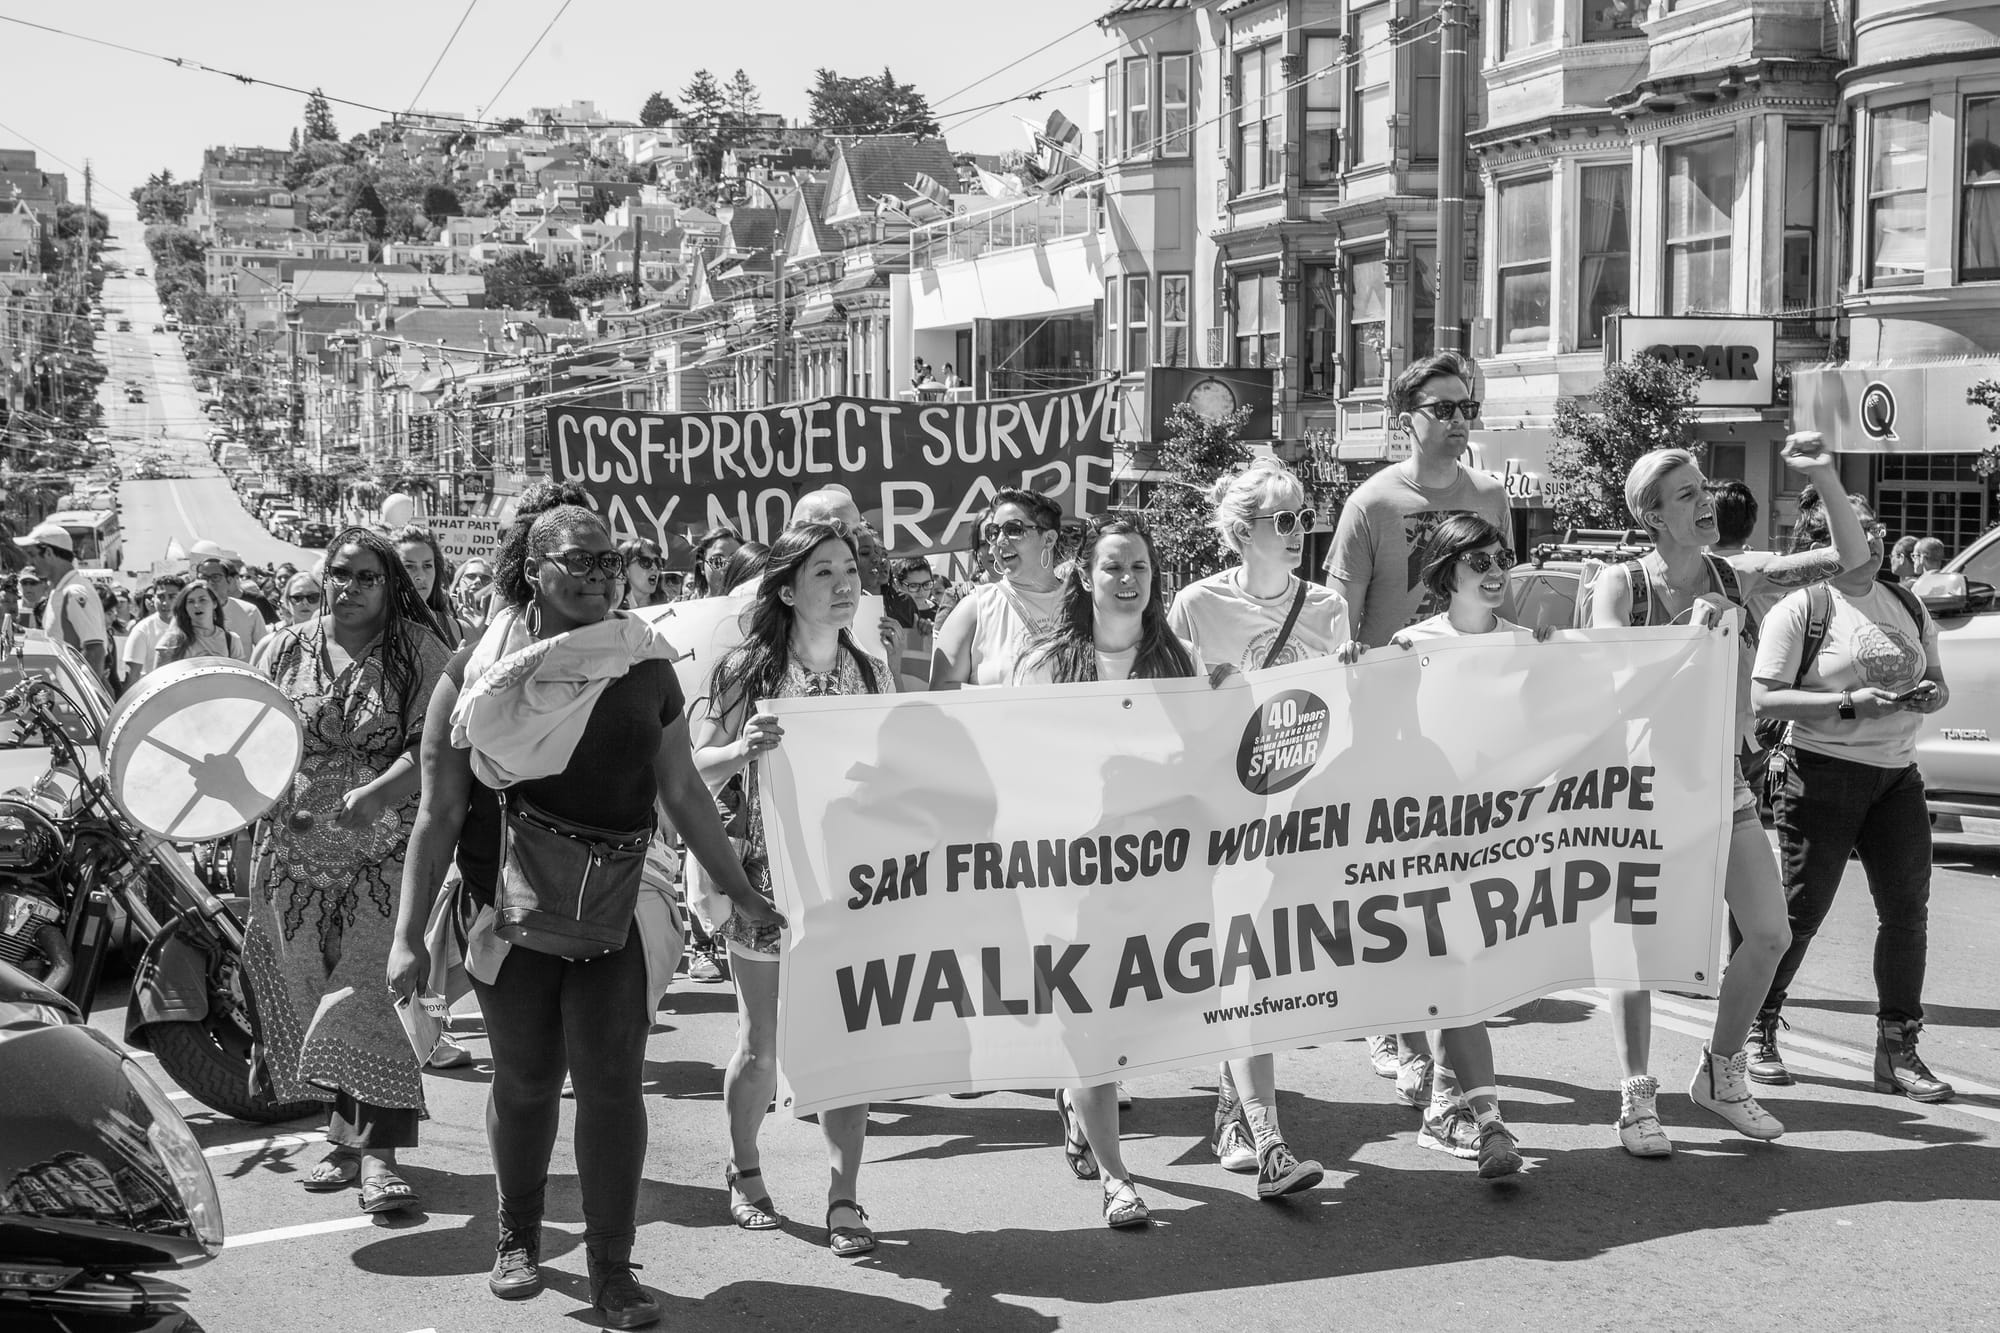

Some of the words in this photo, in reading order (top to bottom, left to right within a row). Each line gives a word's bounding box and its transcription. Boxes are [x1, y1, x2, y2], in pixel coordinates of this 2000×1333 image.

[428, 519, 465, 529] WHAT
[467, 520, 500, 531] PART
[472, 534, 495, 545] DID
[585, 492, 681, 560] AY
[441, 545, 463, 556] OU
[466, 546, 495, 557] NOT
[1268, 699, 1297, 729] 40
[1297, 709, 1326, 726] years
[1252, 741, 1277, 754] WOMEN
[1276, 734, 1304, 749] AGAINST
[1304, 730, 1321, 742] RAPE
[1254, 734, 1271, 745] SAN
[1275, 721, 1323, 740] FRANCISCO
[1248, 740, 1319, 777] SFWAR
[847, 851, 930, 909] SAN
[945, 828, 1190, 893] FRANCISCO
[1208, 803, 1350, 866] WOMEN
[1365, 786, 1545, 844] AGAINST
[1547, 766, 1655, 814] RAPE
[1344, 859, 1396, 885] SAN
[1403, 831, 1555, 878] FRANCISCO'S
[1557, 827, 1664, 851] ANNUAL
[836, 943, 1093, 1033] WALK
[1109, 887, 1451, 1008] AGAINST
[1470, 859, 1661, 948] RAPE
[1203, 990, 1338, 1025] www.sfwar.org
